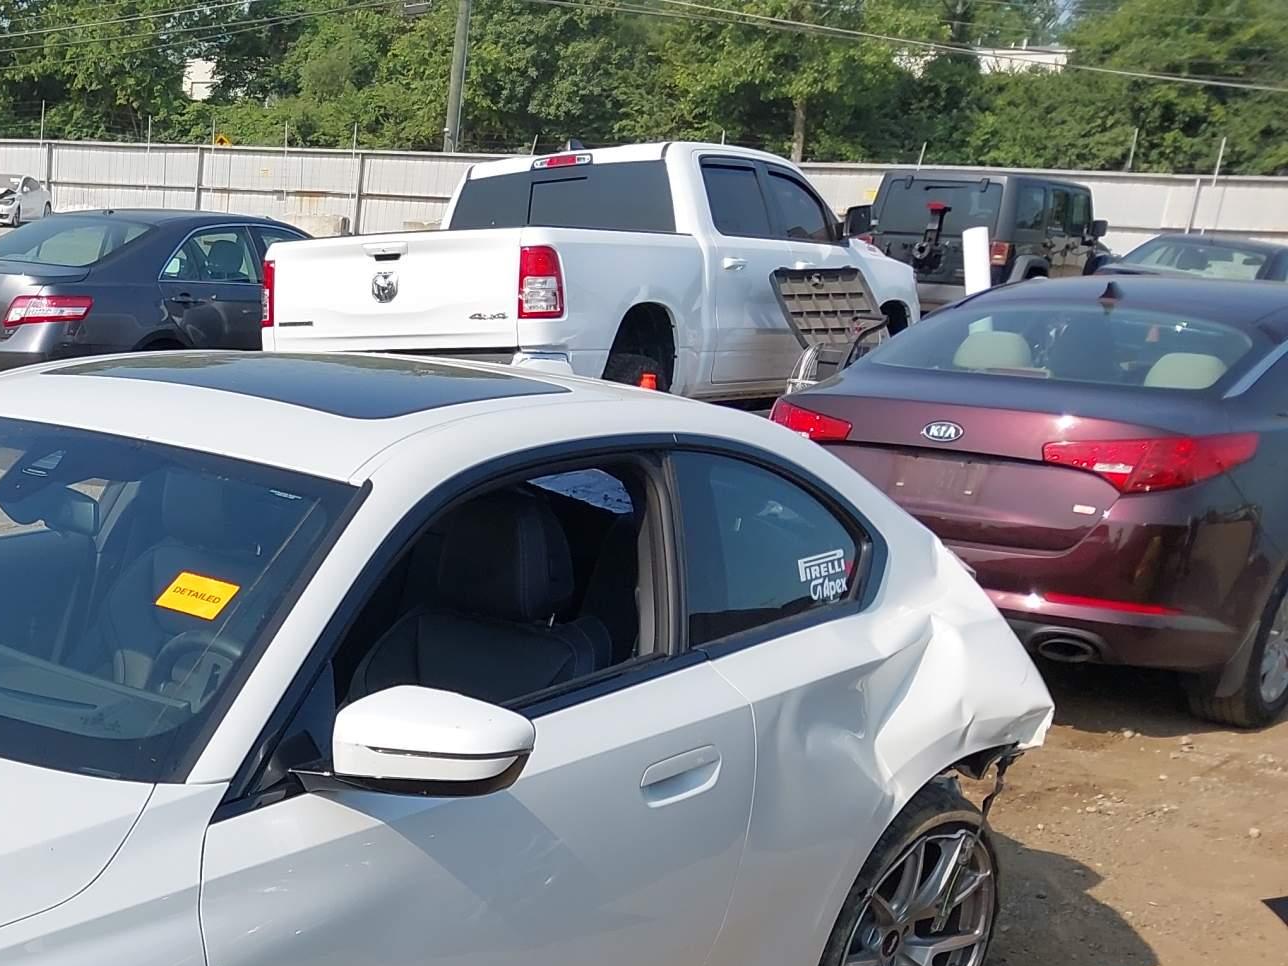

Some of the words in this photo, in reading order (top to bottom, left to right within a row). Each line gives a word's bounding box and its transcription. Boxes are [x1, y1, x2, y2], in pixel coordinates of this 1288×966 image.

[929, 425, 956, 438] KIA
[797, 549, 846, 582] PIRELLI
[173, 586, 221, 604] DETAILED
